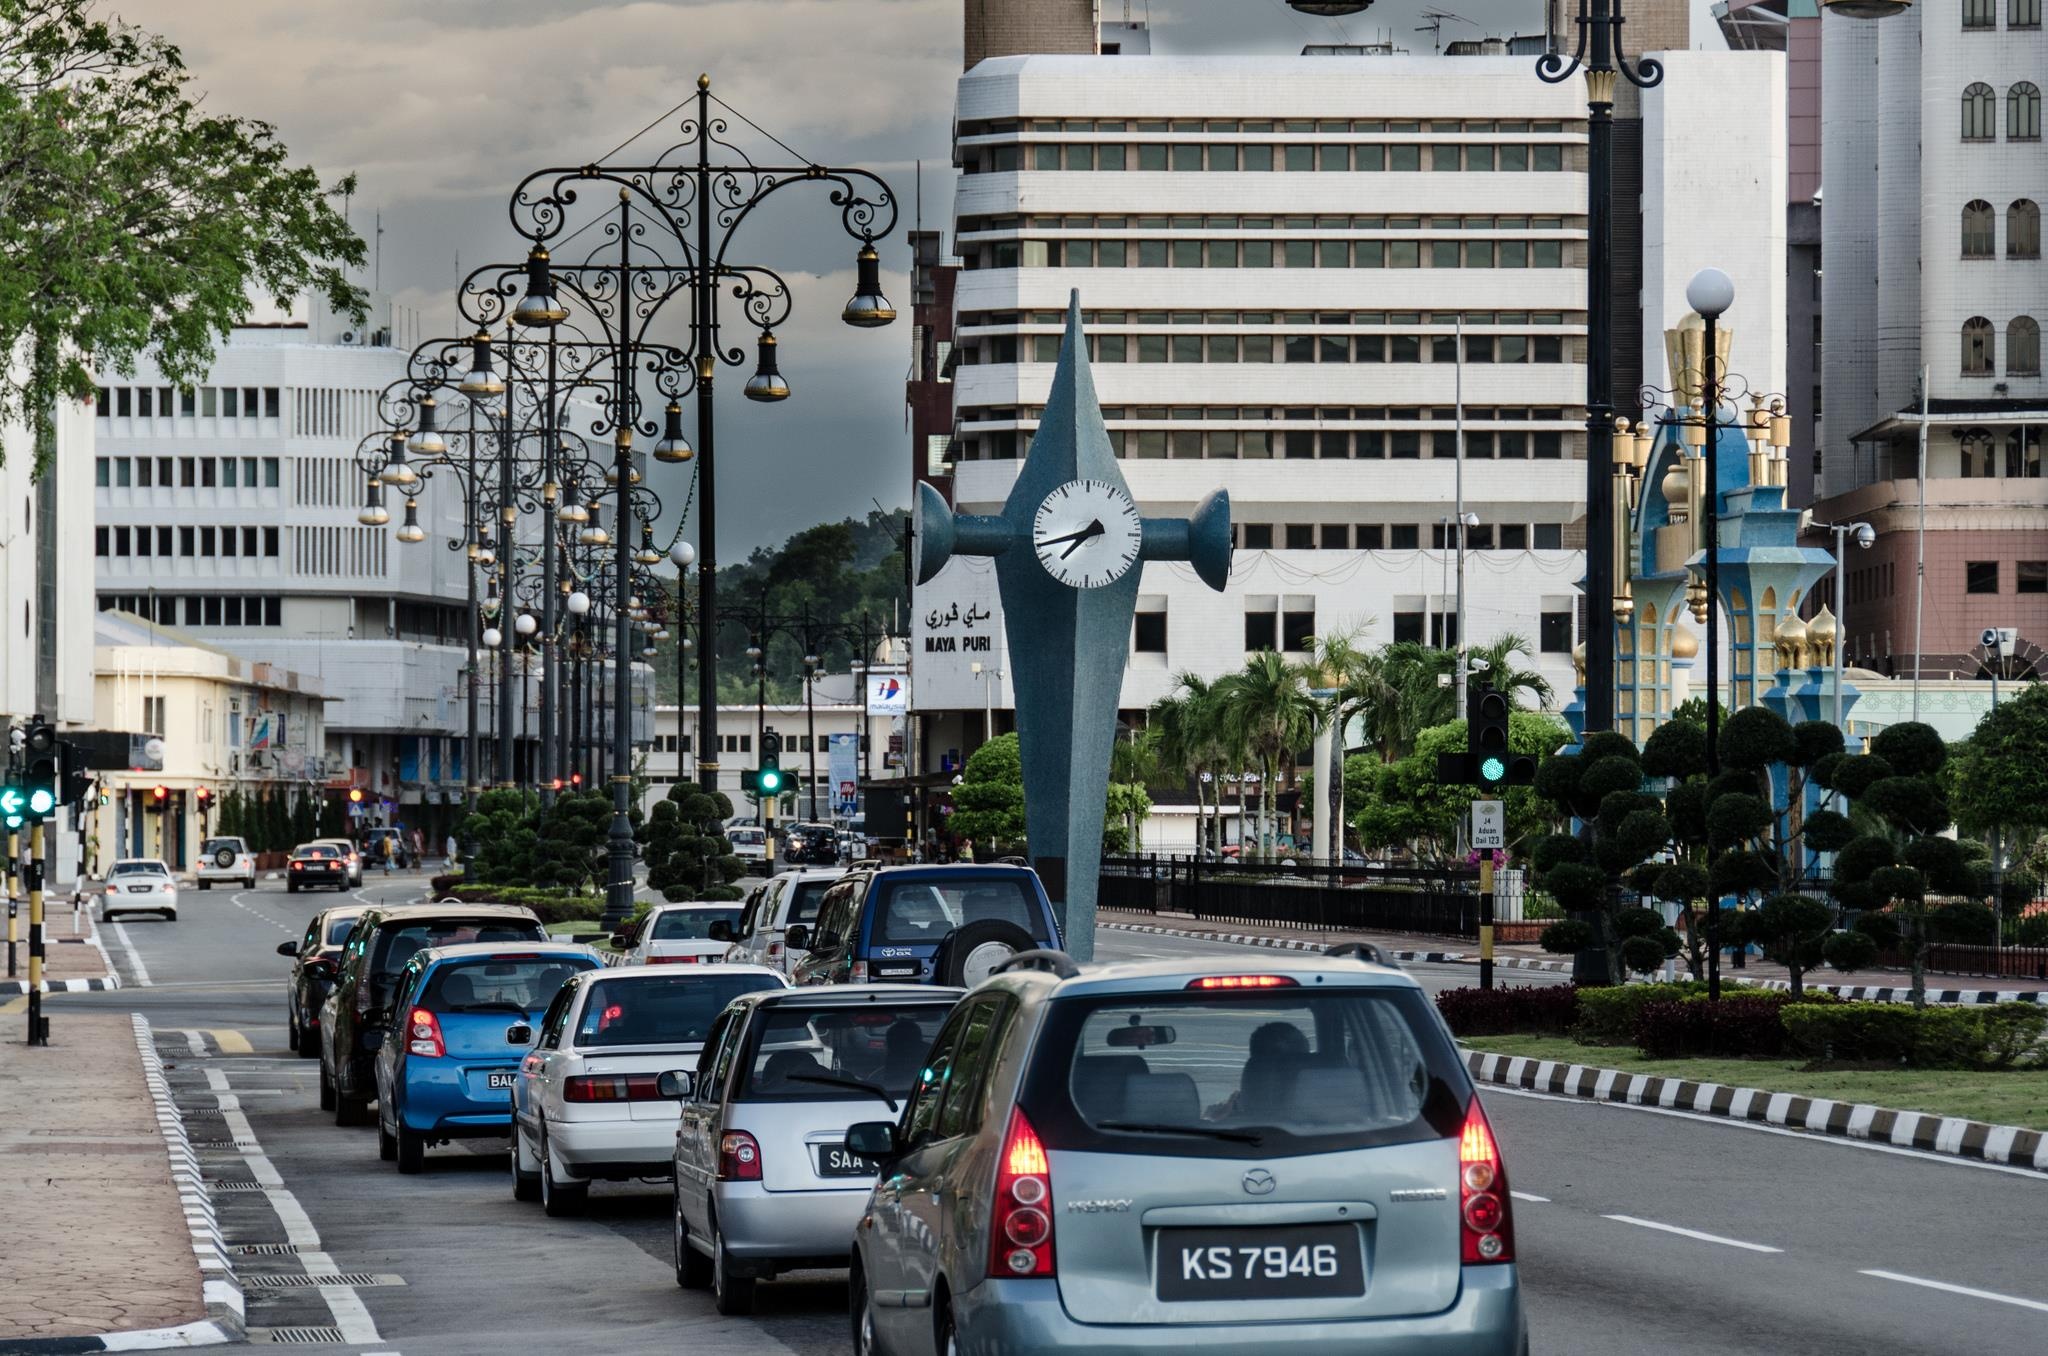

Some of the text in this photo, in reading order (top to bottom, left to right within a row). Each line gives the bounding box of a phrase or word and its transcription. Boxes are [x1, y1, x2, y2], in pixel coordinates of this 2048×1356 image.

[926, 636, 990, 652] MAYA PURI
[1488, 836, 1500, 844] 123
[830, 1151, 863, 1168] SAA
[1182, 1244, 1338, 1280] KS 7946
